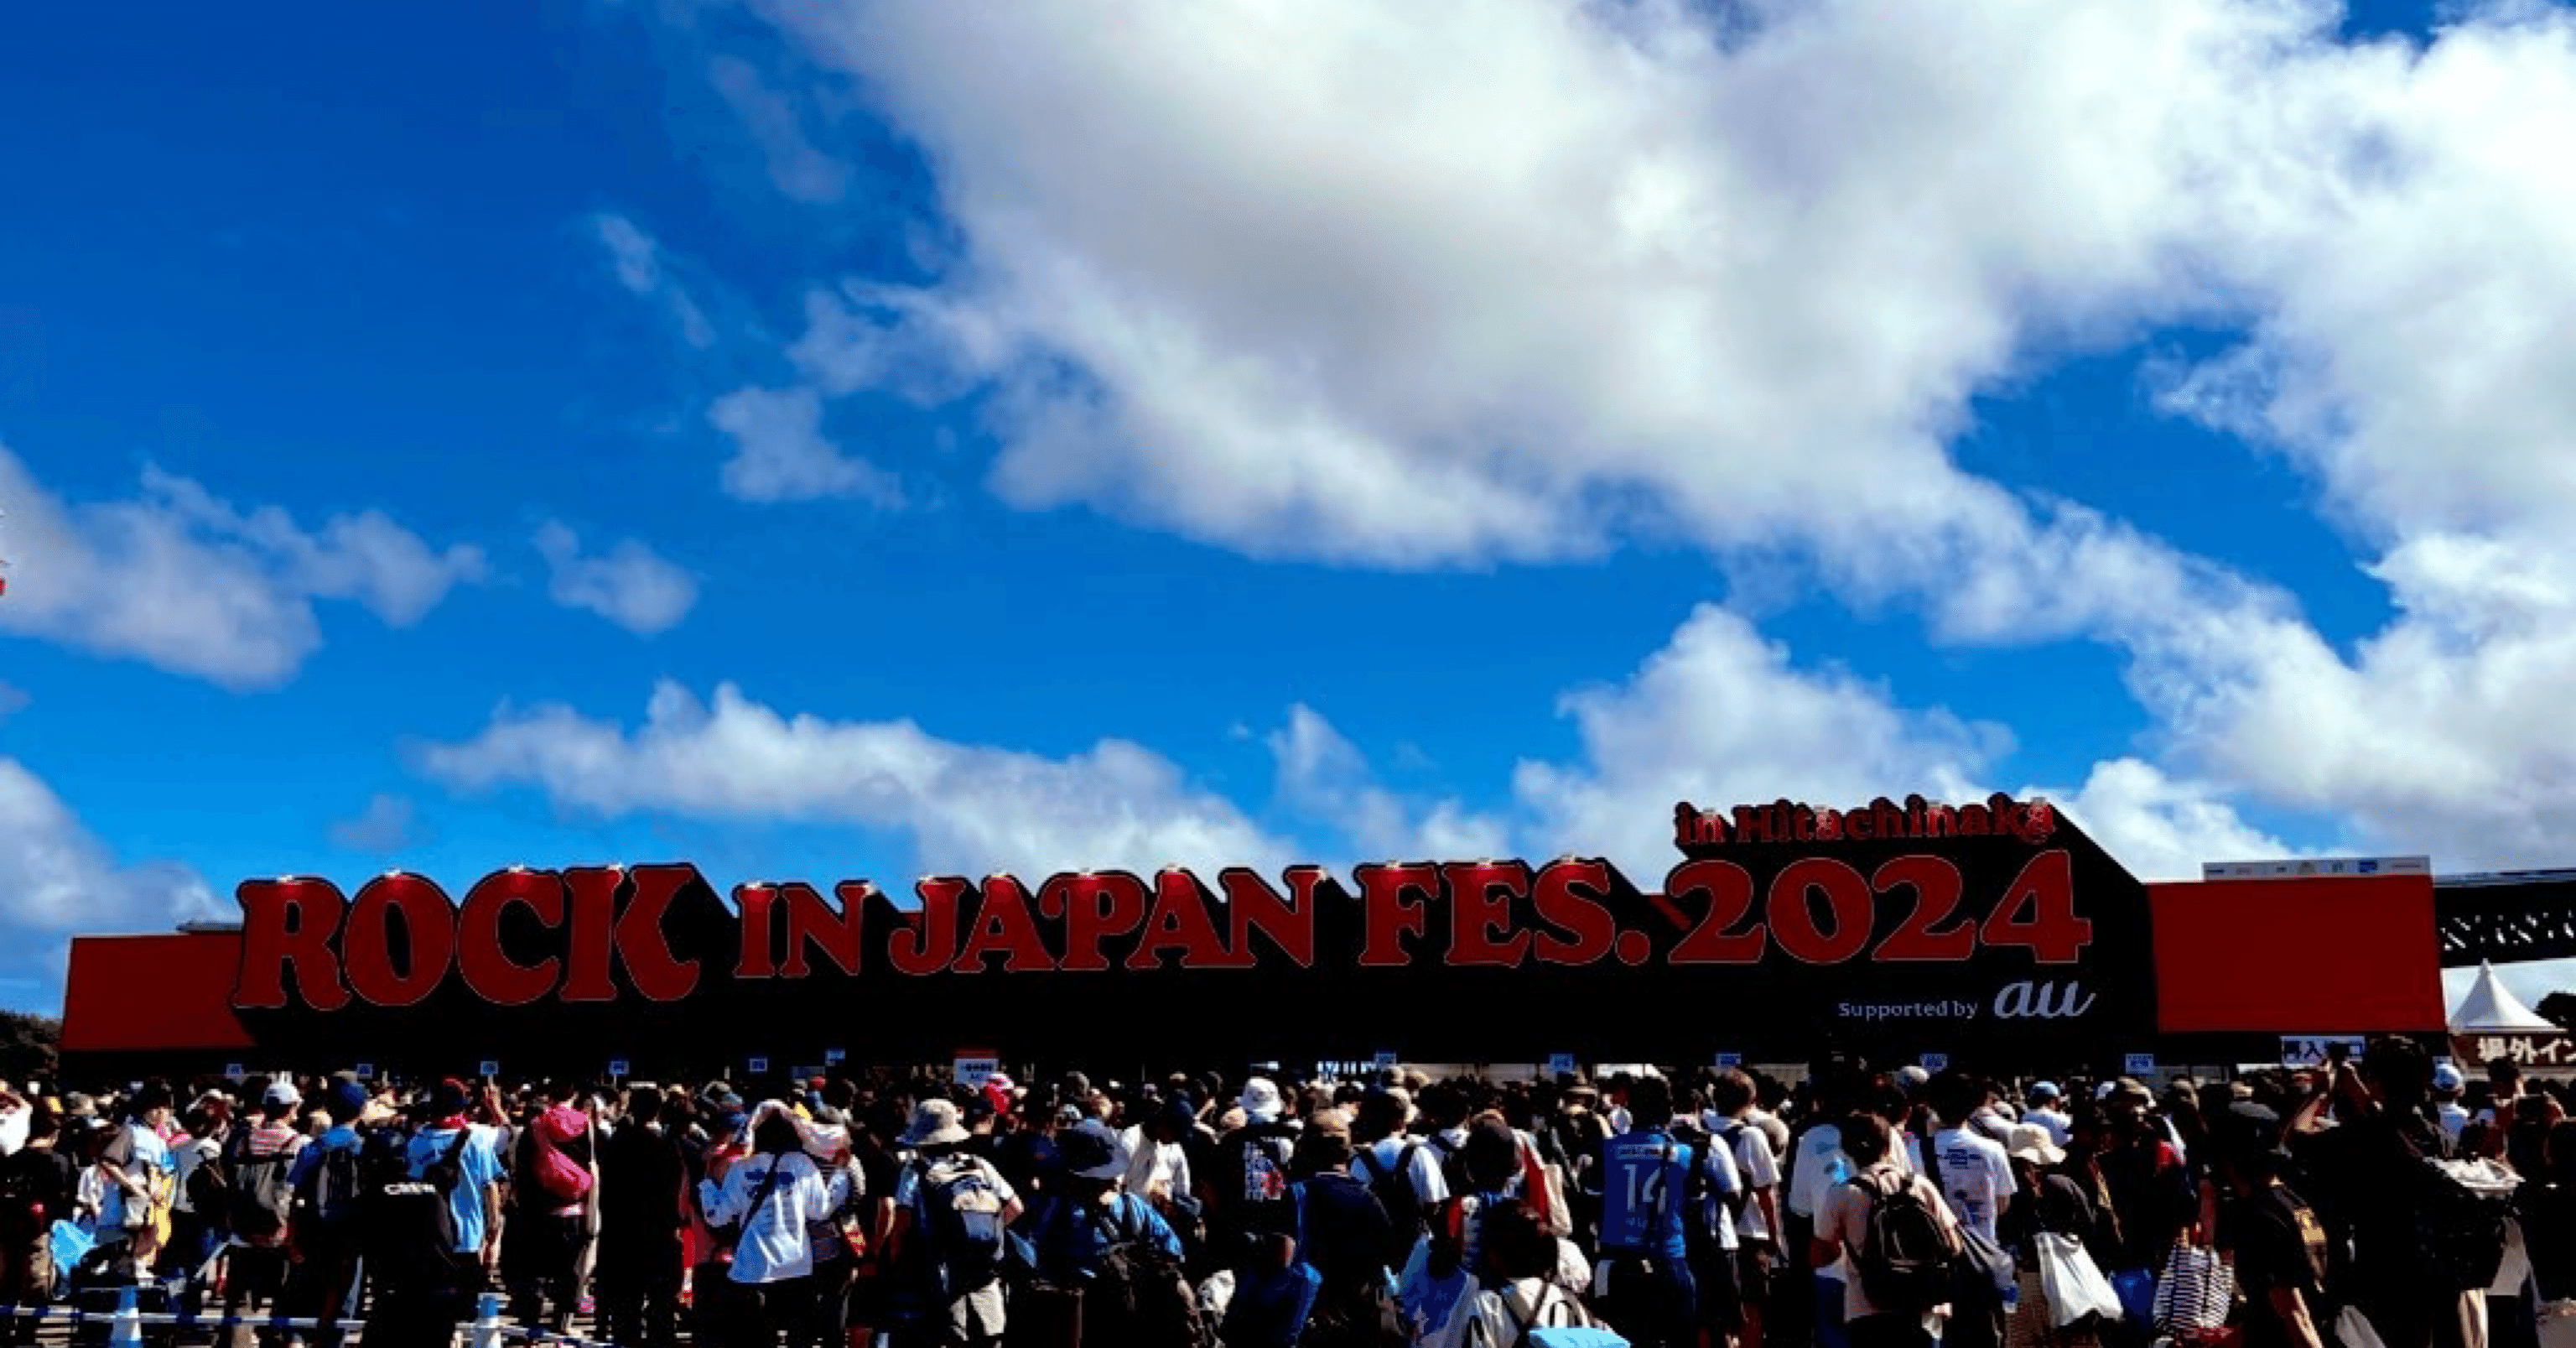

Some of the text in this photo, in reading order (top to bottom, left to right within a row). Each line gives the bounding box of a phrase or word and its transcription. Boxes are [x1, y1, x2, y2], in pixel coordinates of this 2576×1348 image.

[1675, 793, 2055, 845] in Hitachinaka
[232, 849, 2093, 1010] ROCK IN JAPAN FES. 2024
[1838, 980, 2096, 1022] Supported by au
[2284, 1039, 2363, 1059] 再入口
[1622, 1163, 1668, 1216] 14
